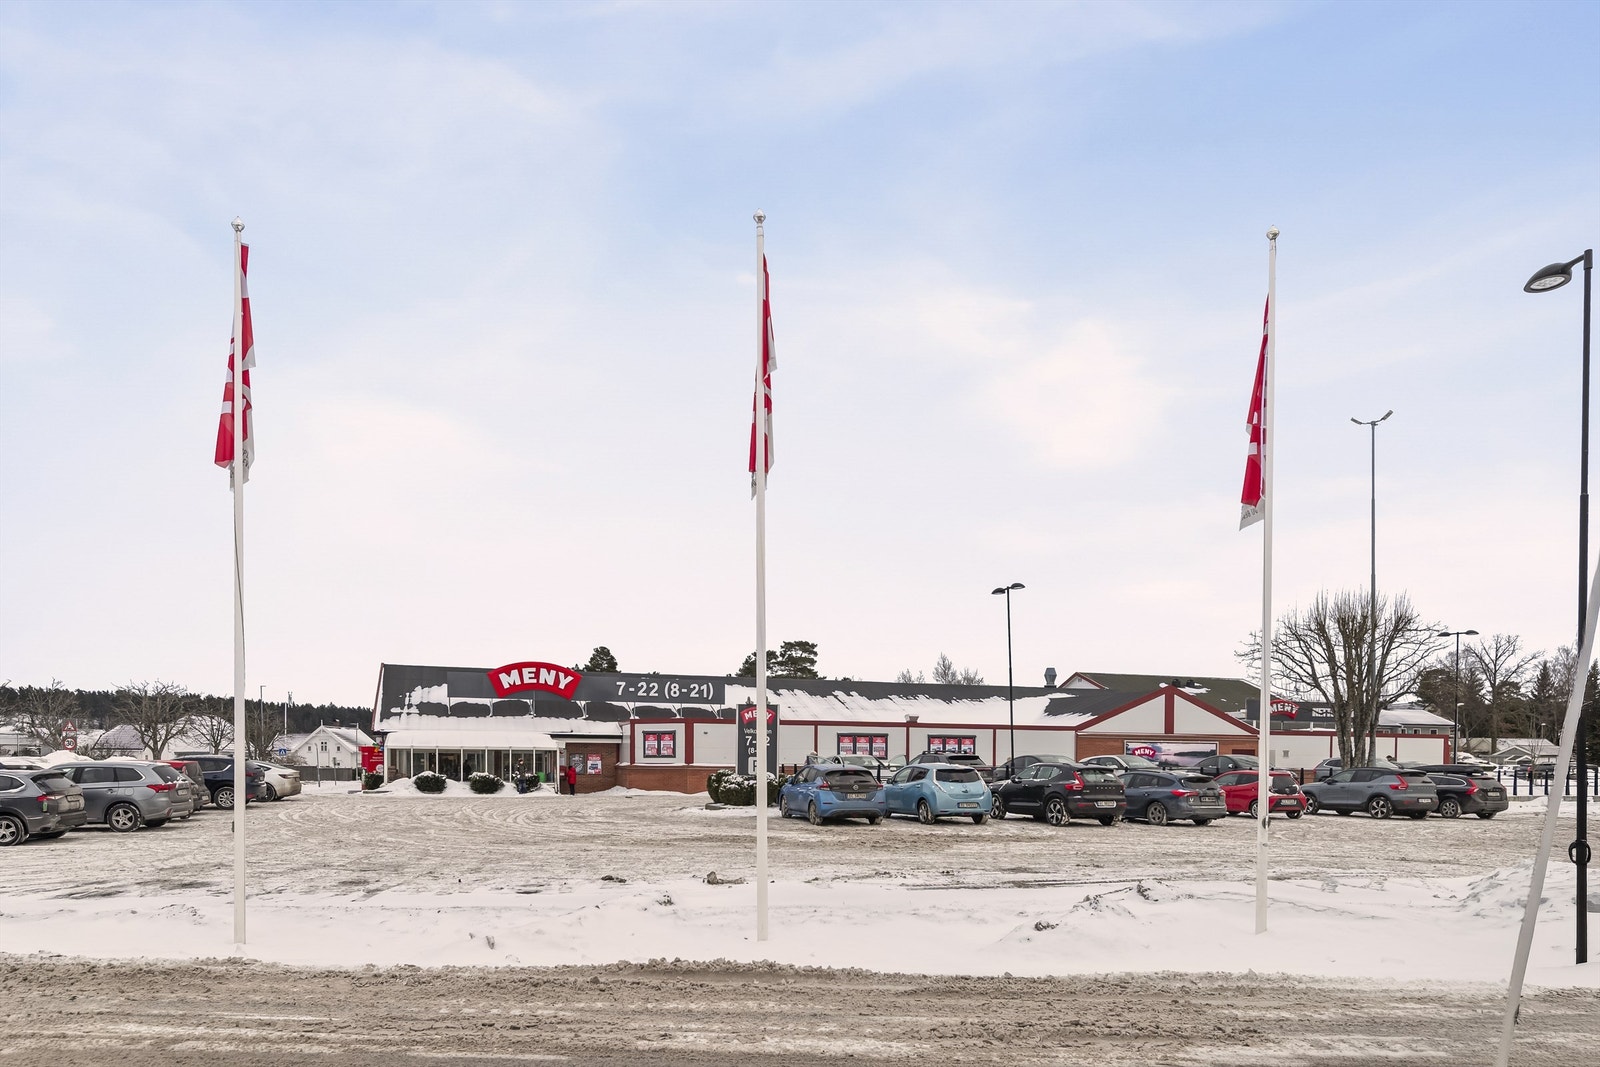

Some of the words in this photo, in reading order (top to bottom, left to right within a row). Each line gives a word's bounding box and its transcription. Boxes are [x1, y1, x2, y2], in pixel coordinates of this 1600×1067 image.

[499, 667, 574, 690] MENY
[616, 681, 659, 697] 7-22
[664, 681, 714, 700] (8-21)
[744, 710, 772, 720] MEY
[1135, 748, 1154, 756] MENY
